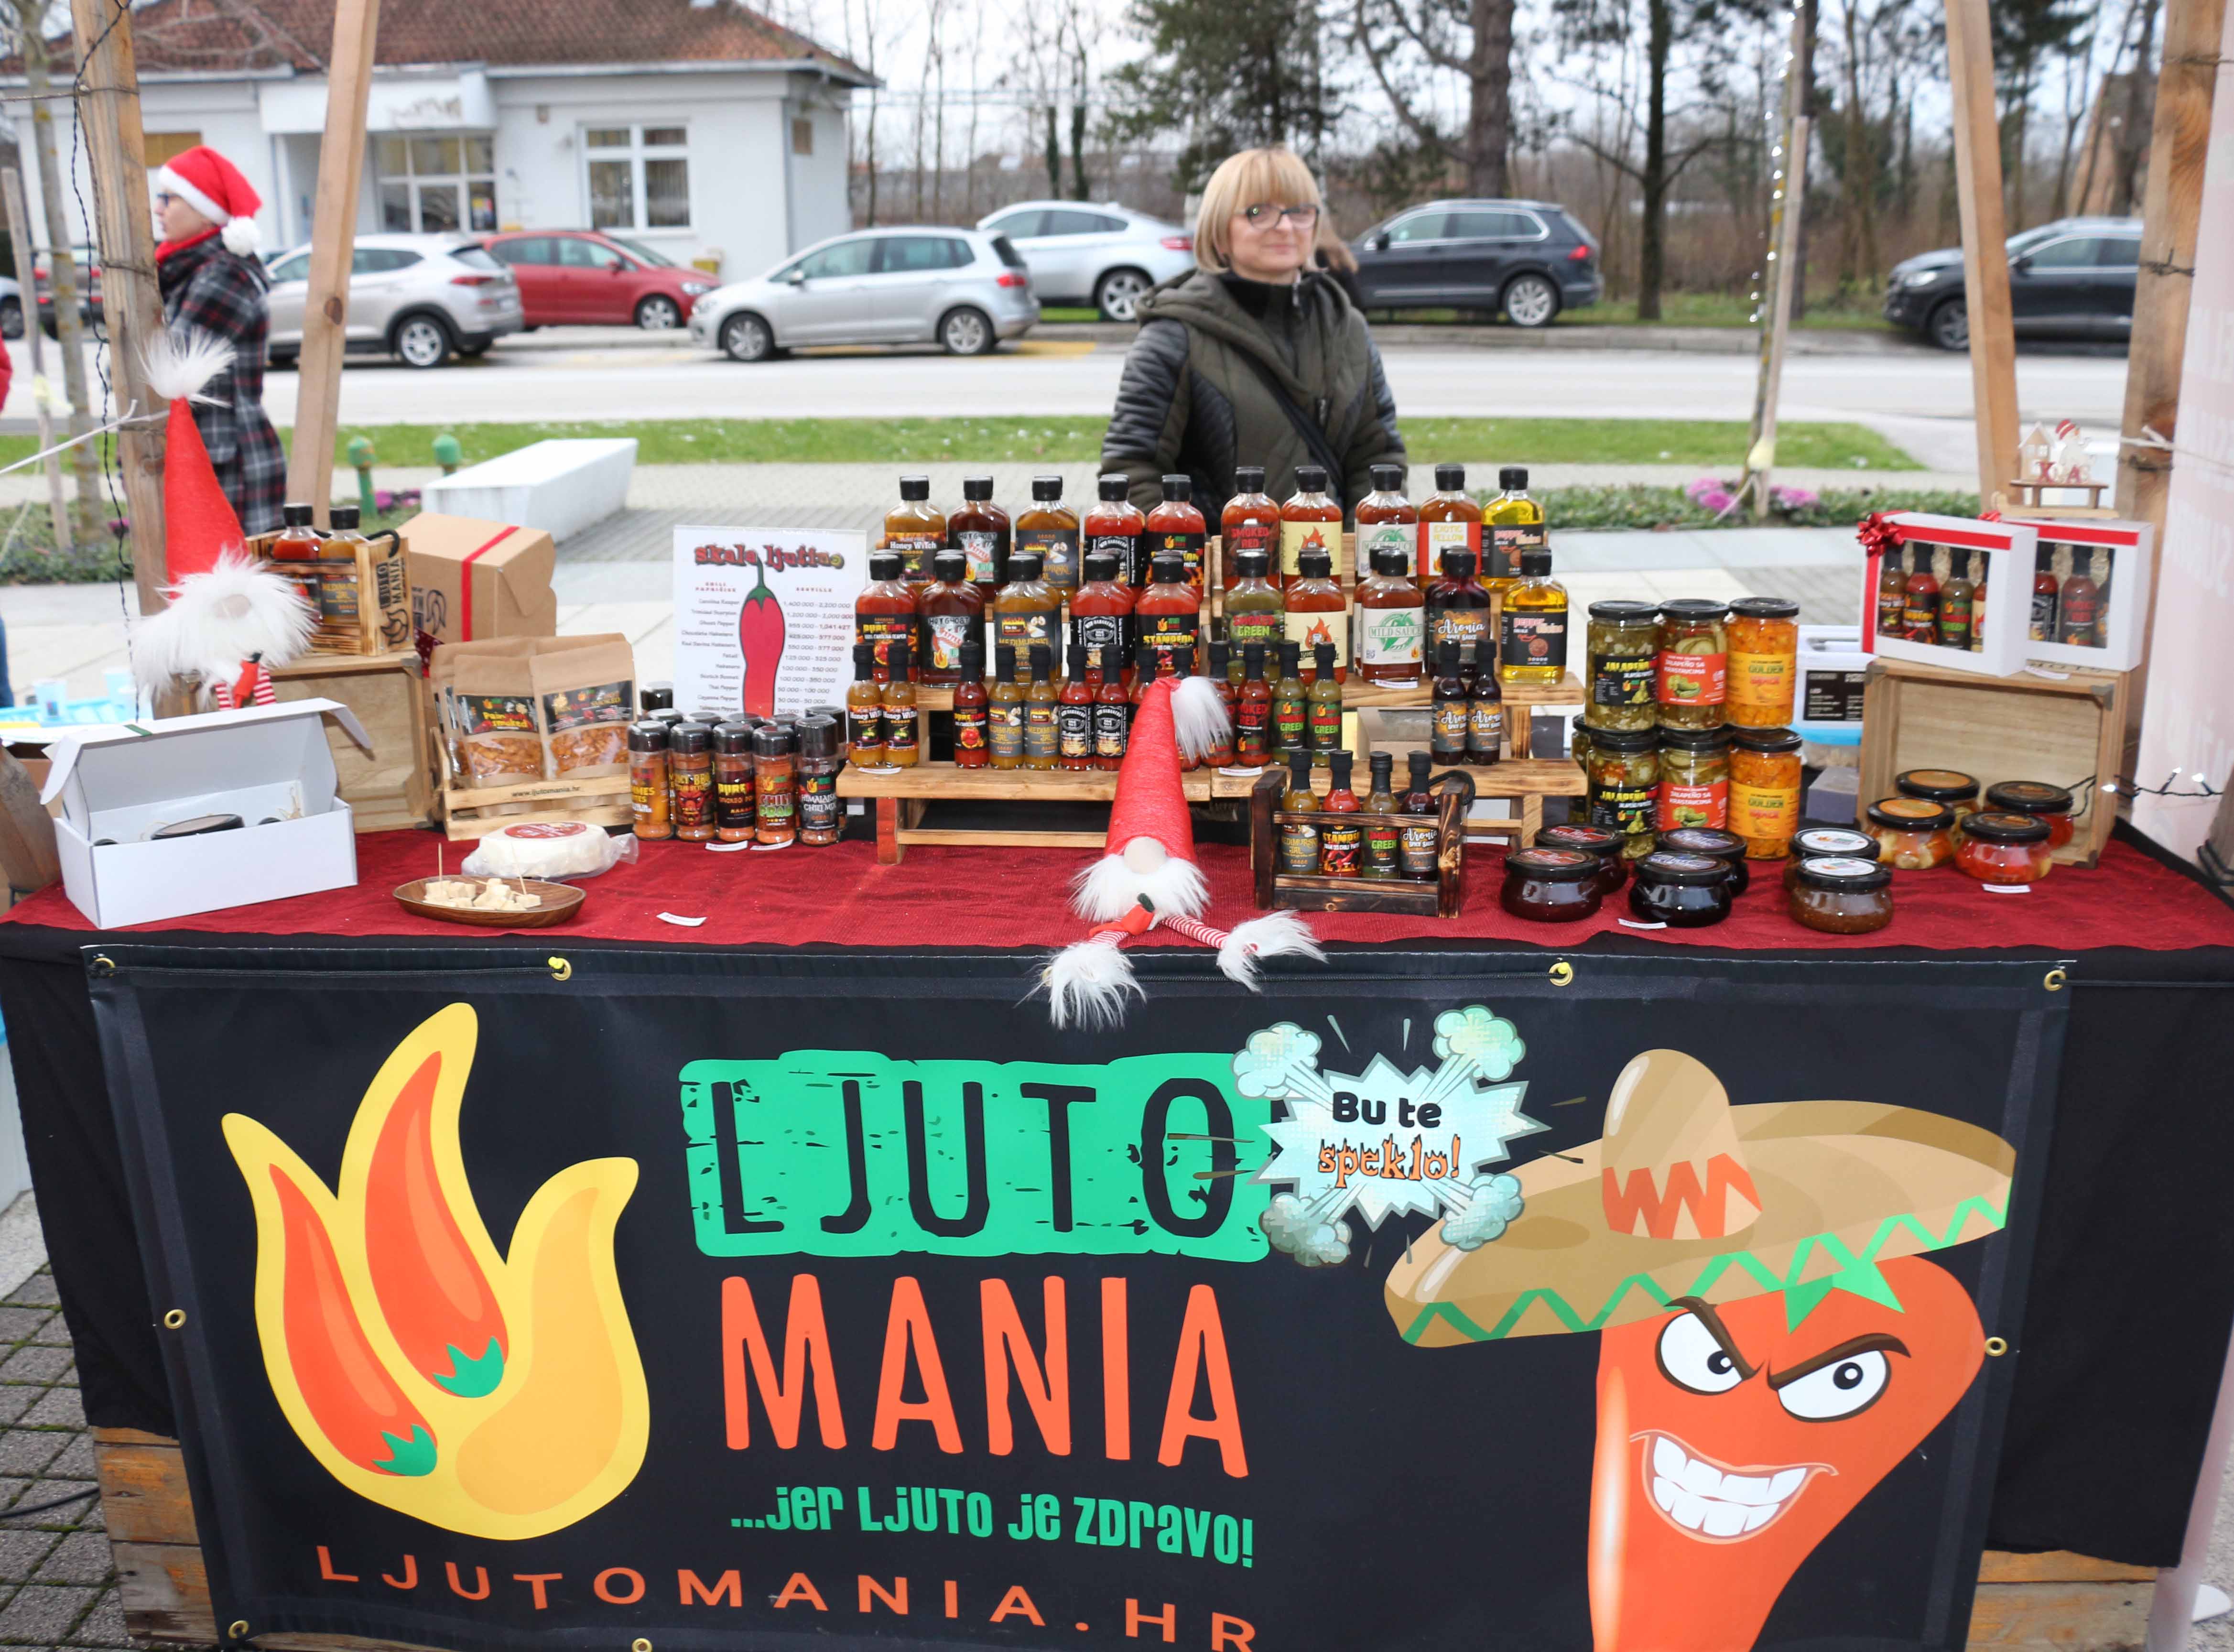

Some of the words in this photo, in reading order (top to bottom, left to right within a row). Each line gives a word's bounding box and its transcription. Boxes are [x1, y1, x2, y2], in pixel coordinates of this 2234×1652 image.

[1231, 527, 1269, 538] SMOKED
[890, 541, 912, 550] Honey
[1241, 539, 1260, 548] RED
[694, 543, 759, 566] skala
[1238, 625, 1270, 637] GREEN
[1370, 627, 1393, 636] MILD
[1394, 627, 1422, 637] SAUCE
[1438, 619, 1485, 634] Aronia
[1239, 715, 1258, 726] RED
[1280, 722, 1304, 731] GREEN
[1315, 725, 1338, 734] GREEN
[511, 785, 581, 798] www.ljutomania.hr
[1371, 840, 1396, 849] GREEN
[1333, 1091, 1386, 1125] Bu
[1399, 1098, 1442, 1128] te
[711, 1077, 1236, 1239] LJUTO
[1318, 1133, 1461, 1188] speklo!
[721, 1273, 1249, 1478] MANIA
[1008, 1490, 1061, 1541] je
[316, 1545, 1256, 1652] LJUTOMANIA.HR
